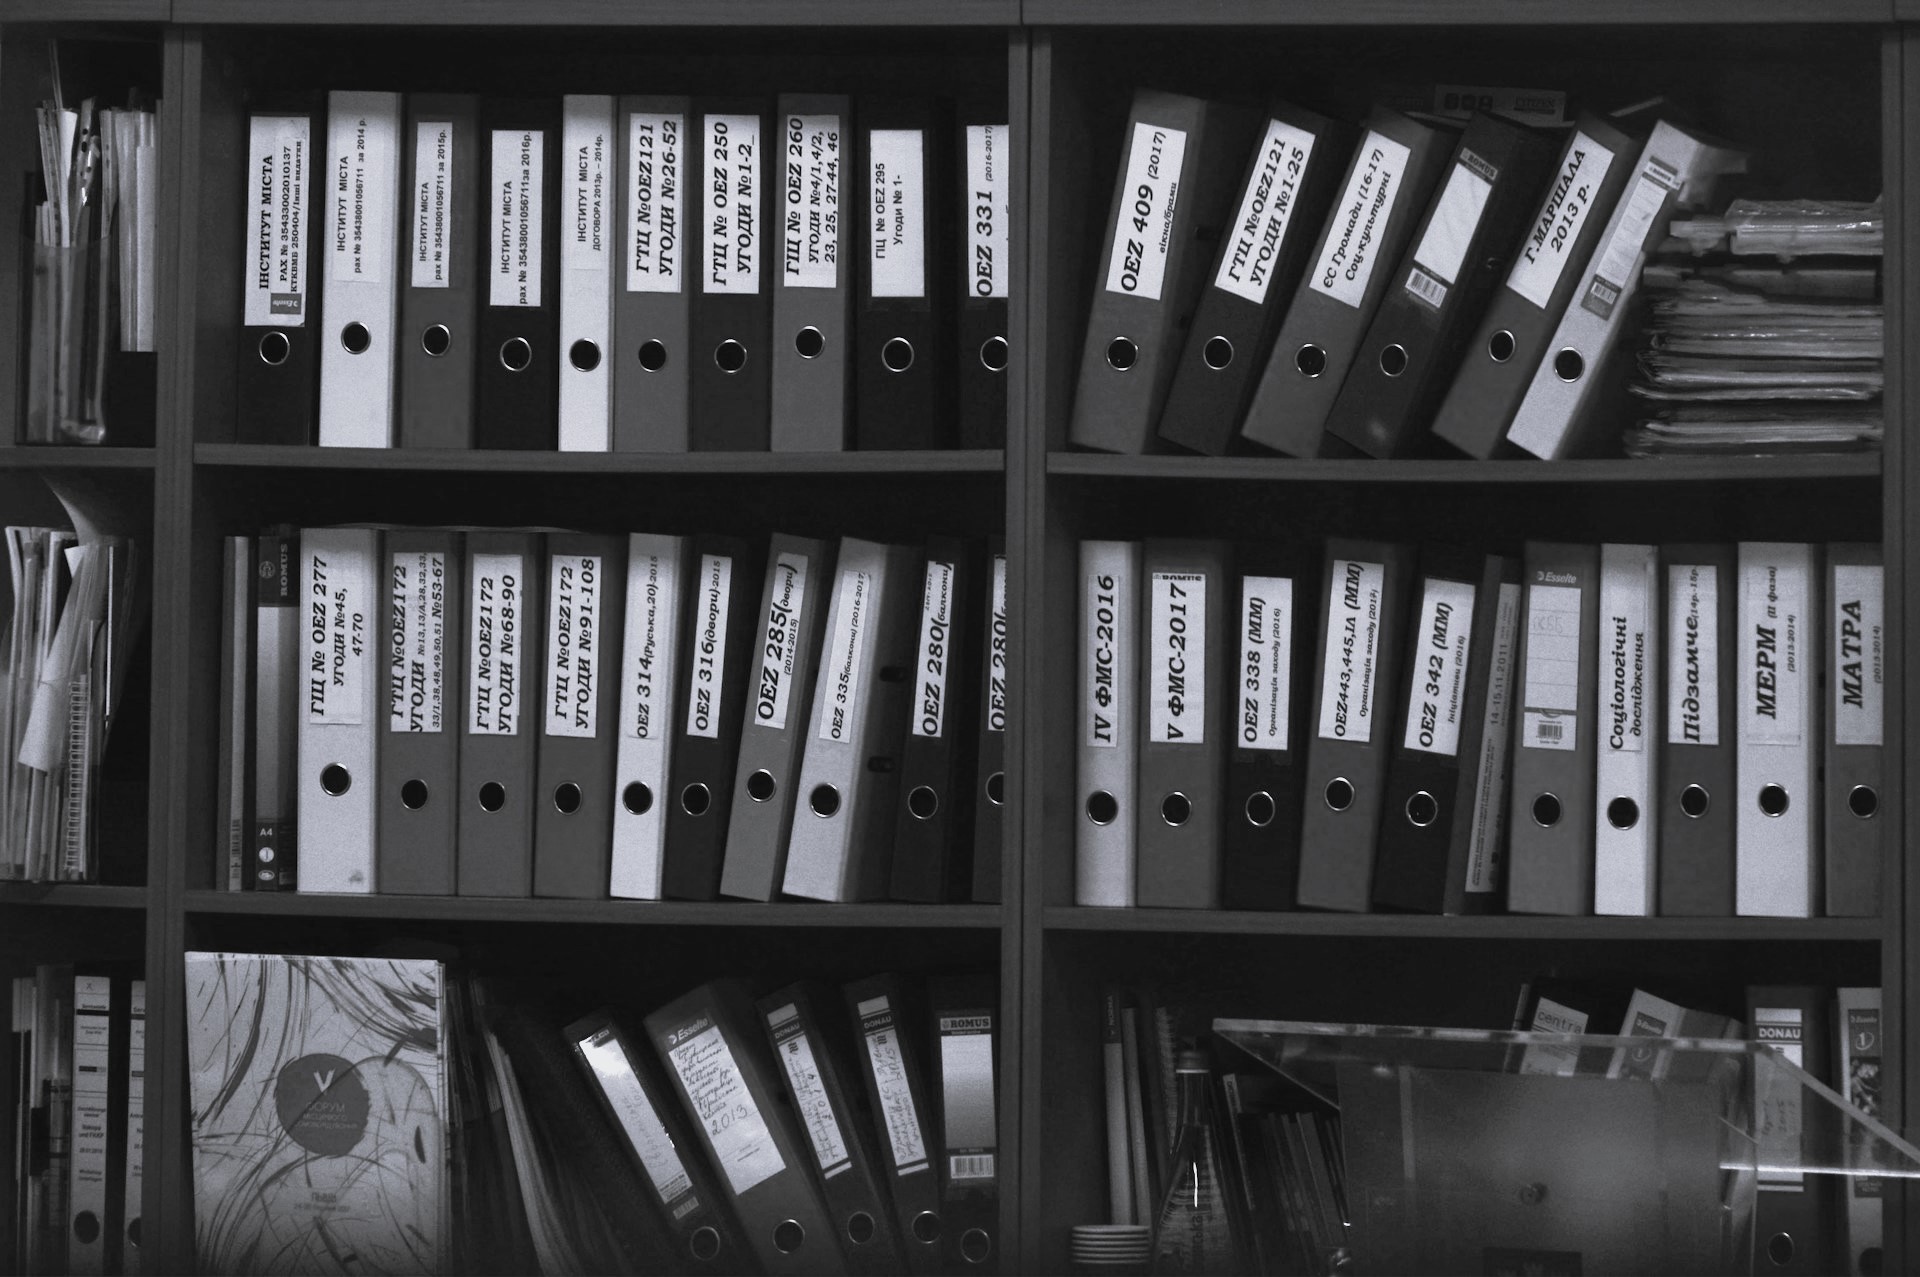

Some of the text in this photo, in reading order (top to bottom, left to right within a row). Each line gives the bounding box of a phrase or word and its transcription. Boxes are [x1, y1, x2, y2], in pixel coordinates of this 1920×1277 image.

[521, 131, 532, 166] 2016р.
[714, 121, 728, 162] 250
[789, 117, 803, 158] 260
[1467, 153, 1497, 178] ROMUS
[353, 118, 367, 274] рах № 35438001056711 за 2014 р.
[578, 146, 589, 242] ІНСТИТУТ МІСТА
[593, 134, 604, 251] ДОГОВОРА 2013р. 2014р.
[660, 119, 677, 277] УГОДИ №26-52
[809, 130, 824, 264] УГОДИ №4/1,4/2,
[825, 131, 839, 264] 23, 25, 27-44, 46
[876, 162, 885, 185] 295
[876, 187, 885, 215] OEZ
[893, 189, 903, 205] №
[259, 155, 273, 290] ІНСТИТУТ МІСТА
[280, 146, 291, 282] РАХ № 35433002010137
[337, 155, 349, 252] ІНСТИТУТ МІСТА
[419, 182, 430, 262] ІНСТИТУТ МІСТА
[435, 129, 447, 281] рах № 35438001056711 за 2015р.
[501, 181, 512, 274] ІНСТИТУТ МІСТА
[713, 215, 727, 238] №
[787, 210, 801, 234] №
[876, 217, 885, 232] №
[893, 207, 904, 246] Угоди
[976, 125, 993, 297] OEZ 331 (2016-2017)
[1120, 131, 1166, 293] OEZ 409 (2017)
[1158, 181, 1178, 254] вікна/брами
[1249, 146, 1304, 287] УГОДИ №1-25
[1323, 147, 1385, 289] ЄС Громади (16-17)
[1345, 170, 1392, 282] Соц-культурні
[1524, 149, 1586, 265] Г.МАРШАЛА
[1550, 183, 1590, 253] 2013 р.
[636, 229, 652, 273] ГТЦ
[713, 242, 729, 286] ГТЦ
[737, 202, 754, 274] УГОДИ
[1228, 237, 1254, 284] ГТЦ
[518, 270, 527, 282] №
[519, 285, 529, 305] рах
[279, 543, 288, 597] ROMUS
[313, 554, 327, 597] 277
[431, 557, 444, 620] №53-67
[1545, 571, 1577, 584] Esselte
[312, 601, 326, 645] OEZ
[333, 587, 348, 687] УГОДИ №45,
[352, 612, 364, 657] 47-70
[575, 558, 595, 730] УГОДИ №91-108
[758, 562, 798, 721] OEZ 285(двори)
[783, 618, 799, 676] (2014-2015)
[922, 560, 953, 736] OEZ 280(балкони)
[1095, 574, 1114, 708] ФМС-2016
[1168, 582, 1186, 717] ФМС-2017
[1454, 635, 1466, 667] (2016)
[1756, 623, 1776, 720] МЕРМ
[1767, 565, 1778, 603] фаза)
[1787, 614, 1796, 673] (2013-2014)
[312, 650, 326, 674] №
[498, 574, 516, 734] УГОДИ №68-90
[1246, 650, 1261, 692] 338
[1268, 607, 1281, 737] Організація заходу (2016)
[1359, 657, 1373, 718] Організація
[1366, 621, 1376, 656] заходу
[1425, 654, 1444, 697] 342
[1609, 616, 1628, 750] Соціологічні
[1841, 599, 1863, 709] МАТРА
[1872, 625, 1882, 684] (2013-2014)
[391, 674, 406, 718] ГТЦ
[409, 660, 426, 733] УГОДИ
[477, 685, 492, 731] ГТЦ
[555, 674, 570, 720] ГТЦ
[695, 687, 711, 732] OEZ
[831, 628, 858, 740] OEZ 335(балкони)
[1490, 643, 1508, 726] 14-15.11.2011
[1630, 631, 1644, 737] дослідження
[637, 702, 650, 739] OEZ
[1244, 697, 1258, 743] OEZ
[1419, 701, 1438, 748] OEZ
[260, 827, 273, 837] A4
[677, 1017, 709, 1041] Esselte
[774, 1022, 800, 1039] DONAU
[864, 1015, 892, 1029] DONAU
[950, 1018, 990, 1029] ROMUS
[1537, 1011, 1584, 1035] centra
[1759, 1028, 1801, 1039] DONAU
[712, 1104, 748, 1136] 2013
